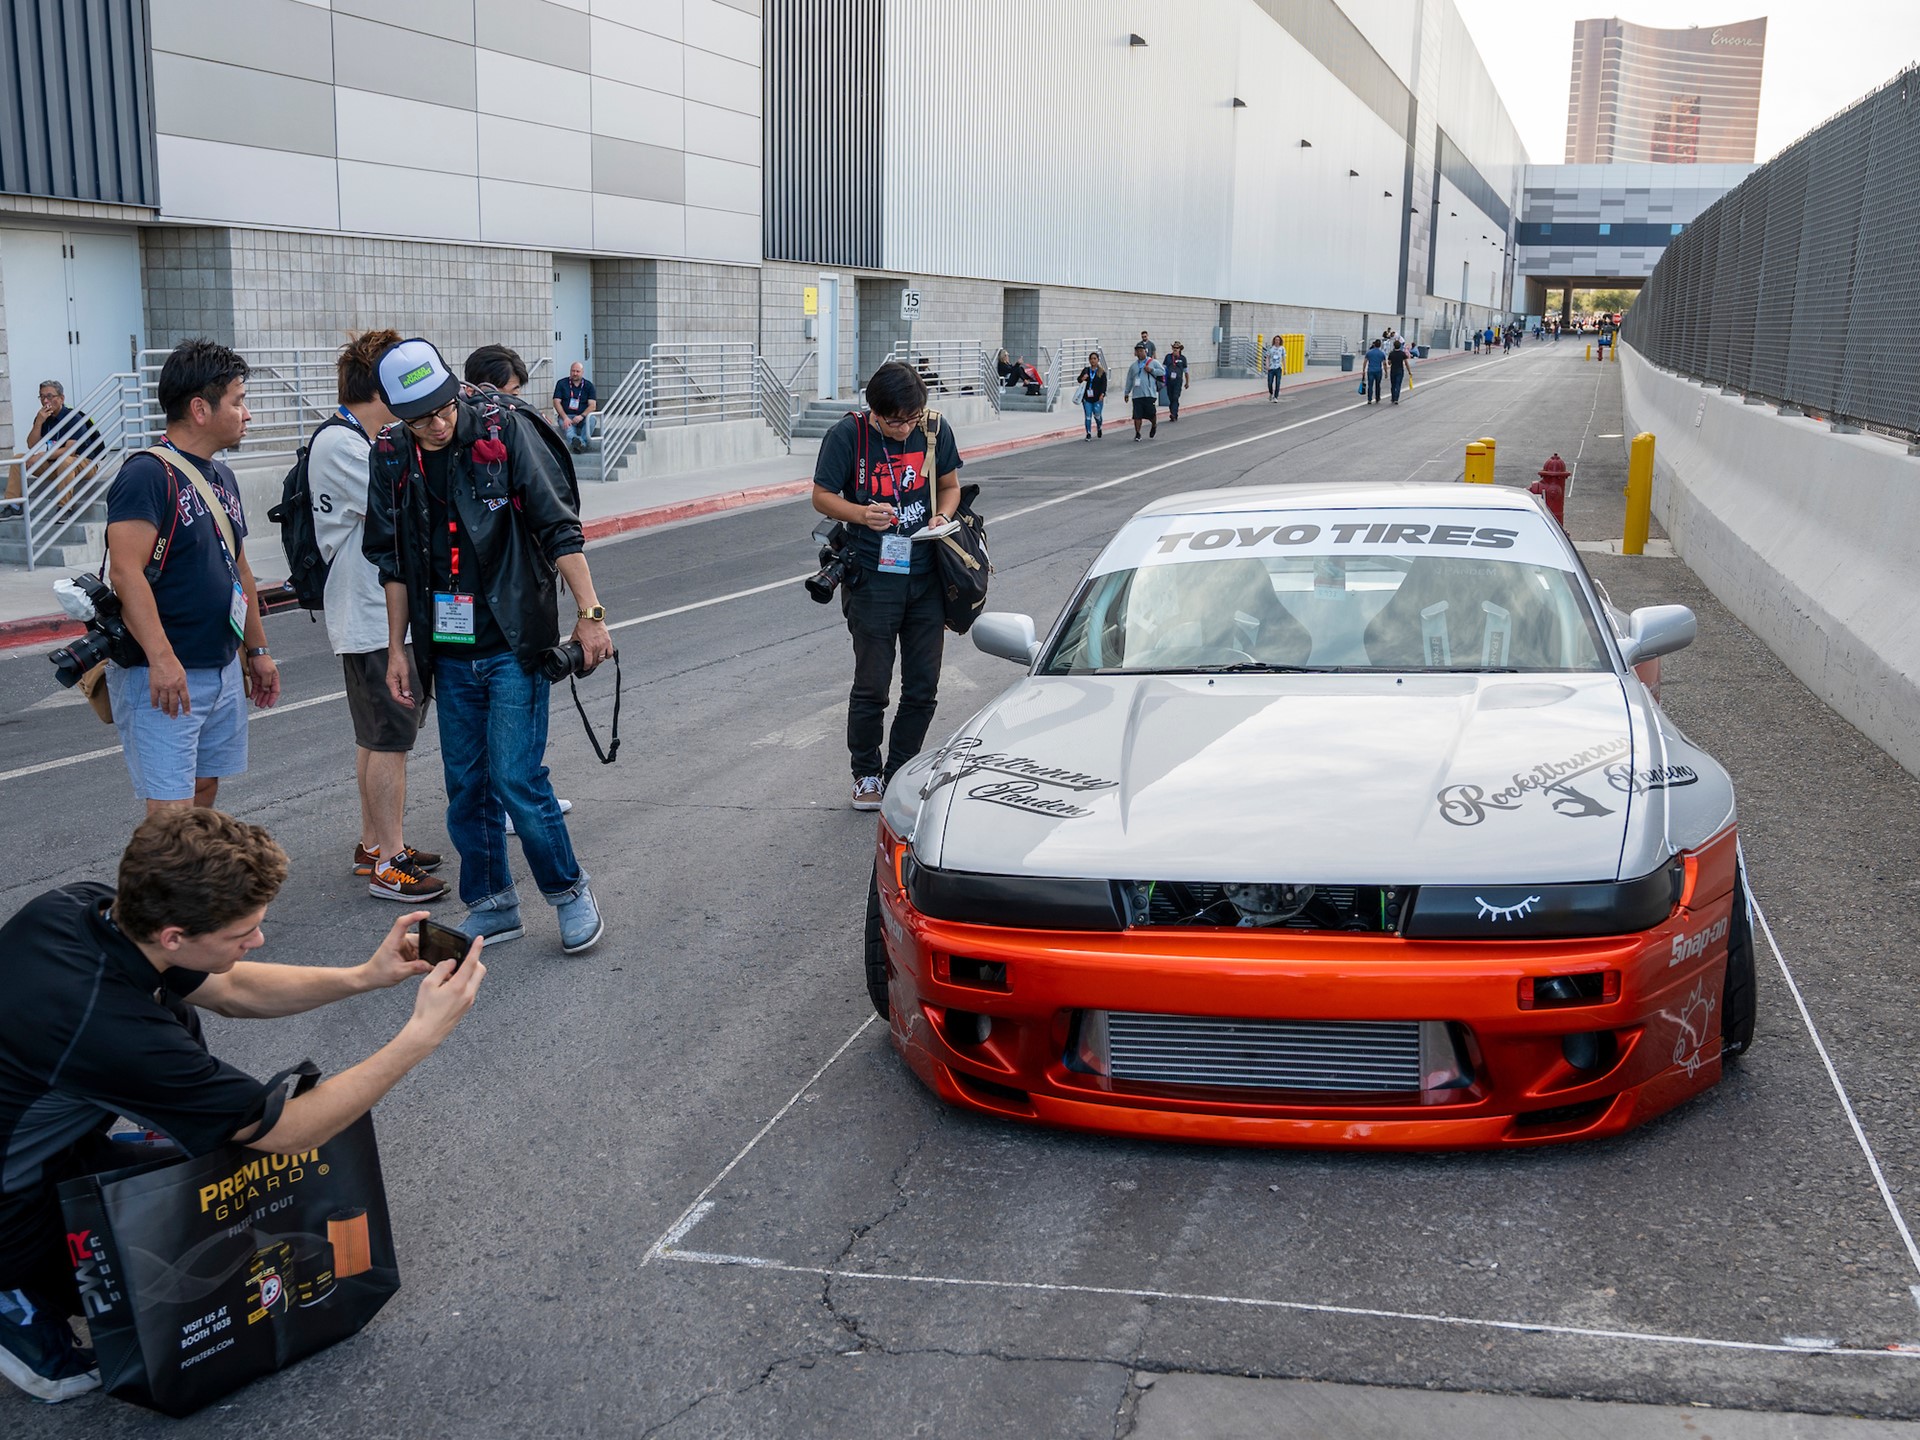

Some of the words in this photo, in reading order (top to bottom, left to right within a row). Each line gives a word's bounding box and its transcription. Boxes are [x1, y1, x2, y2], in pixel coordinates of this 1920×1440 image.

[1710, 27, 1762, 46] Encore
[905, 293, 919, 307] 15
[153, 537, 167, 561] EOS
[1156, 523, 1322, 554] TOYO
[1330, 523, 1520, 549] TIRES
[963, 780, 1096, 819] Pandem
[1669, 916, 1728, 967] Snap-on
[199, 1148, 320, 1214] PREMIUM
[215, 1167, 304, 1221] GUARD
[228, 1214, 254, 1239] FILTER
[256, 1206, 266, 1220] IT
[269, 1194, 295, 1213] OUT
[66, 1229, 113, 1319] PWR
[89, 1236, 122, 1302] STEER
[181, 1327, 210, 1349] BOOTH
[212, 1316, 232, 1333] 1038
[182, 1317, 203, 1335] VISIT
[204, 1311, 216, 1324] US
[217, 1305, 228, 1318] AT
[181, 1337, 235, 1370] PGFILTERS.COM
